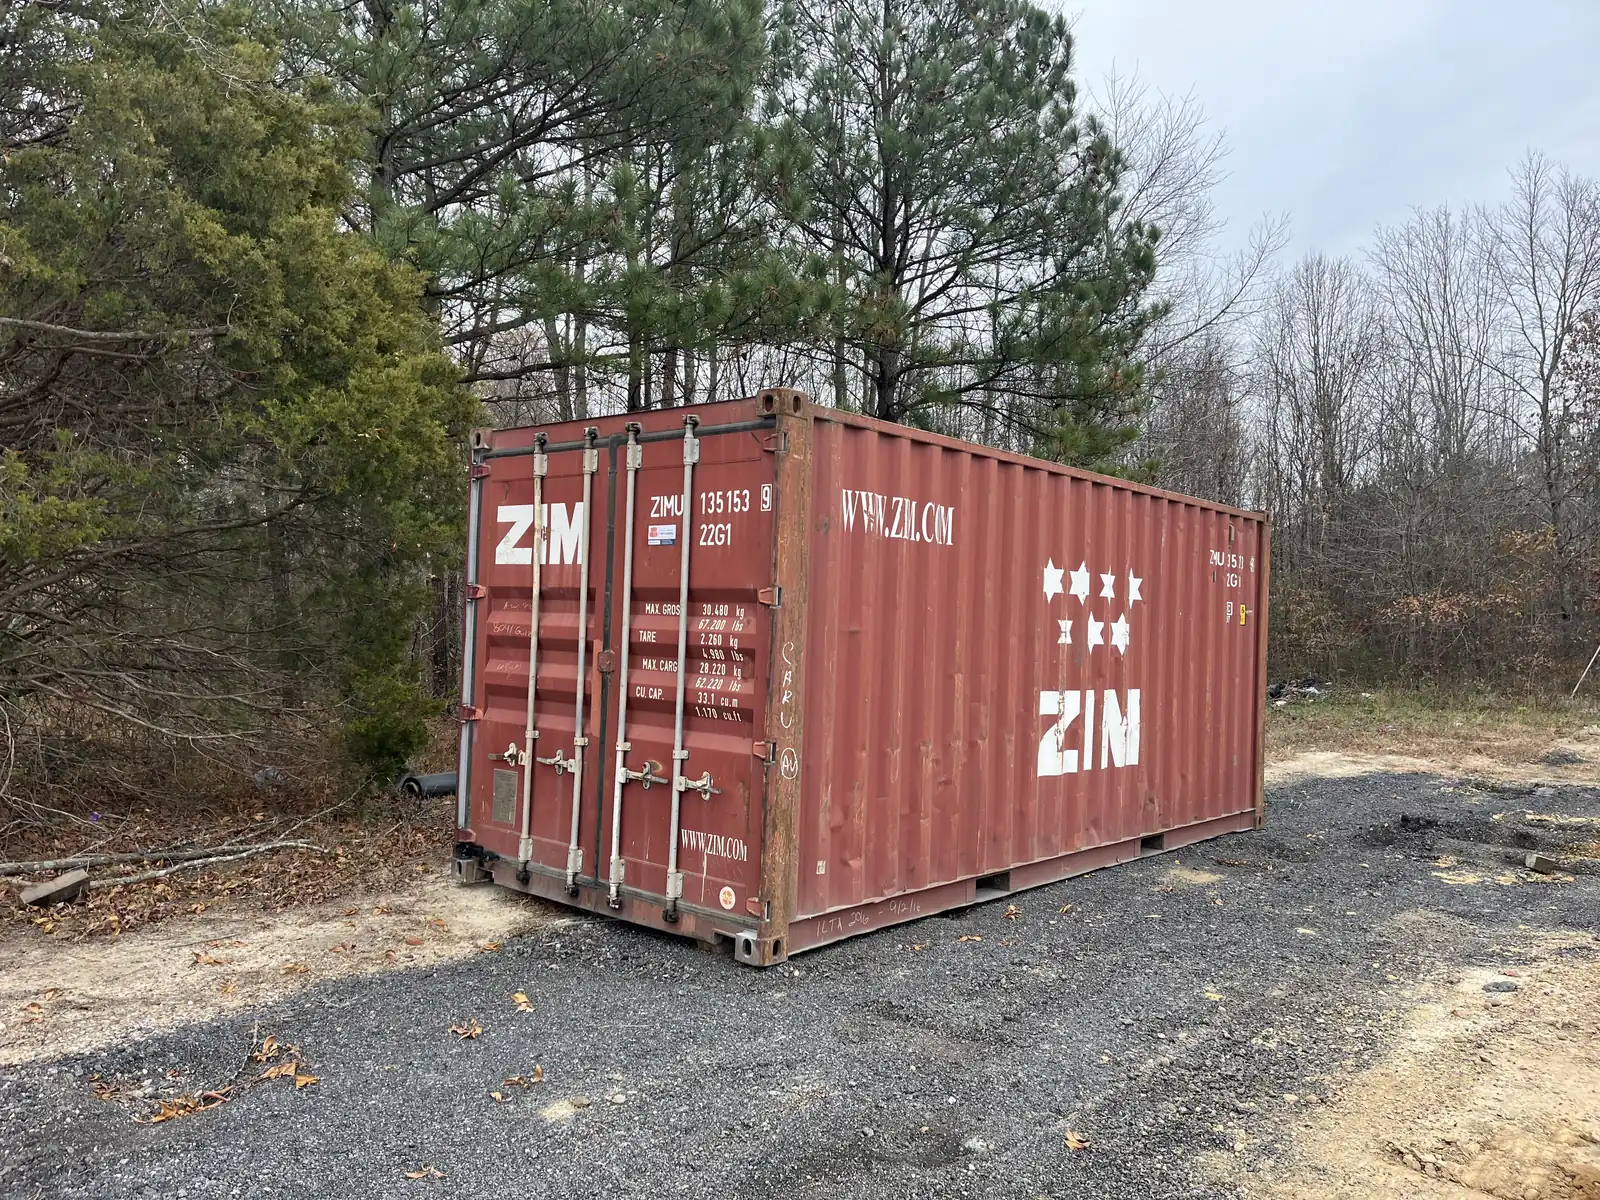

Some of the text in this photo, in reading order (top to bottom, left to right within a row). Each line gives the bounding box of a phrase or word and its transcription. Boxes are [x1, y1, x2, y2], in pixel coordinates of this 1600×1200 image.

[650, 485, 772, 518] ZIMU 135153 9
[495, 502, 584, 565] ZIM
[699, 523, 732, 546] 22G1
[645, 603, 745, 620] MAX. GROS 30.480 kg
[698, 618, 744, 632] 67.200 lbs
[639, 630, 738, 650] TARE 2.260 kg
[702, 648, 744, 661] 4.980 lbs
[642, 658, 742, 680] MAX. CARG 28.220 kg
[695, 677, 742, 692] 62.220 lbs
[635, 686, 739, 708] CU. CAP. 33.1 cu.m
[695, 706, 742, 722] 1.170 cu.ft
[680, 828, 747, 862] WWW.ZIM.COM
